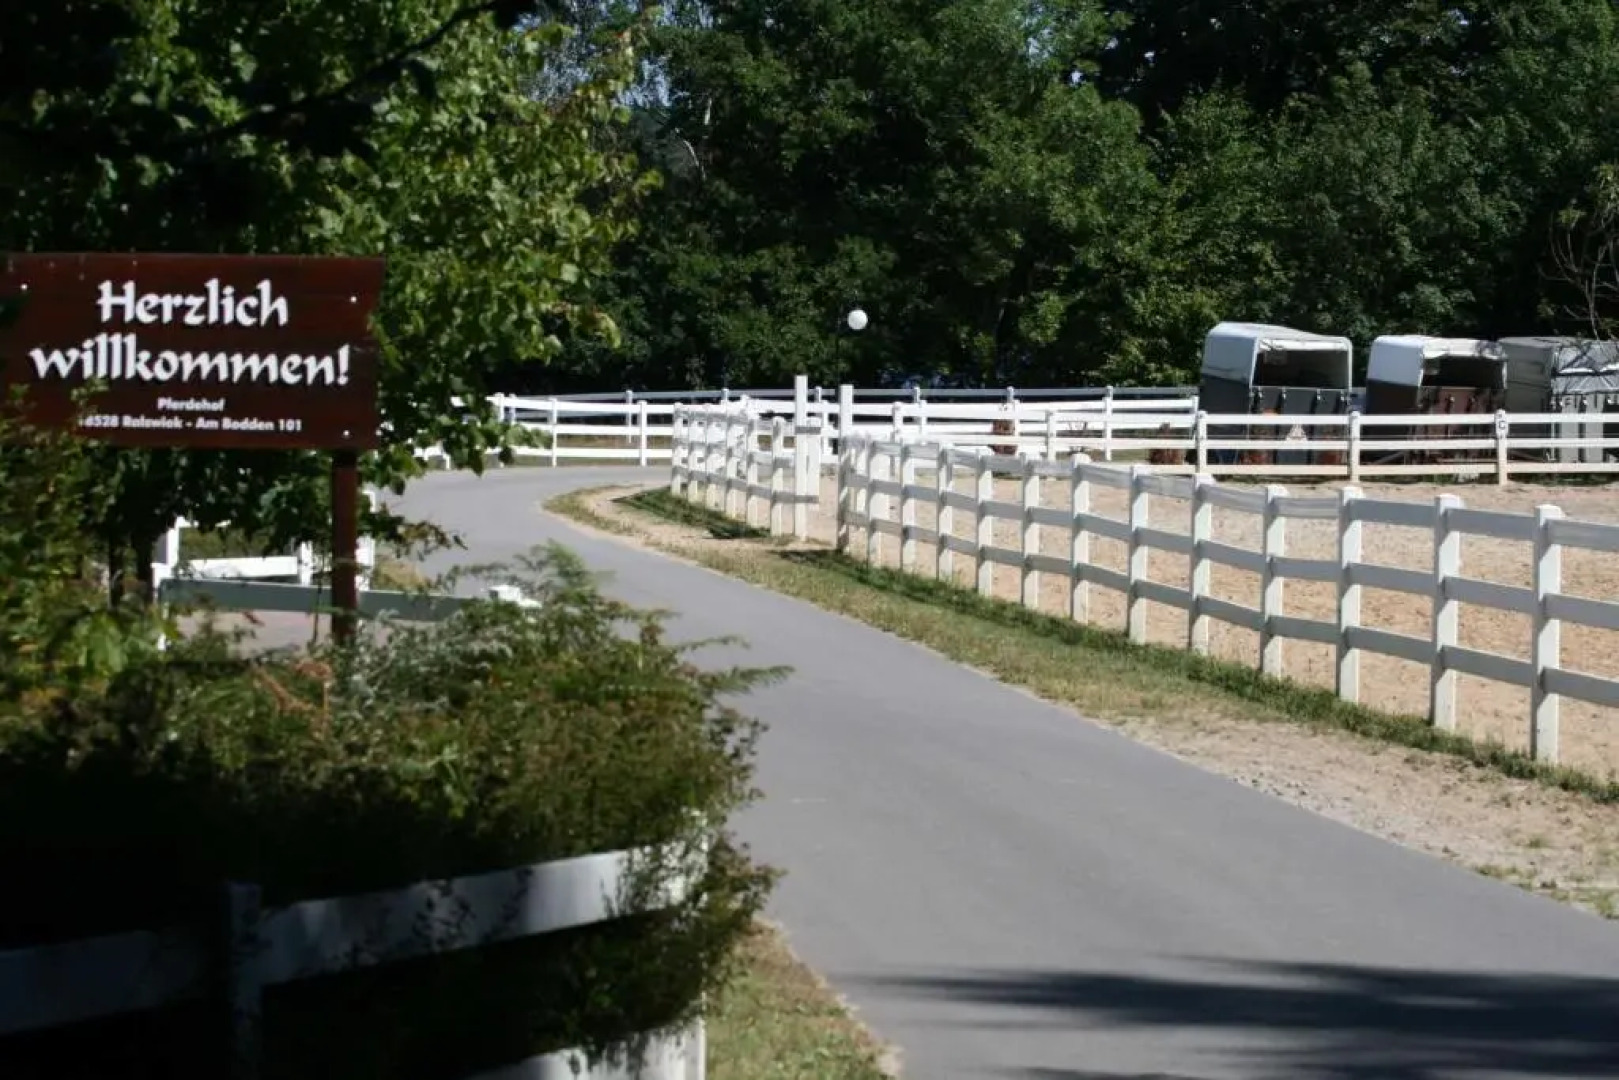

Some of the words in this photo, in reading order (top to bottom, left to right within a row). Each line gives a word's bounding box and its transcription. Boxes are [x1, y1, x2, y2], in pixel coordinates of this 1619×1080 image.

[97, 277, 288, 326] Herzlich
[28, 331, 350, 387] willkommen!
[195, 416, 219, 430] Am
[222, 417, 275, 431] Bodden
[279, 418, 302, 432] 101
